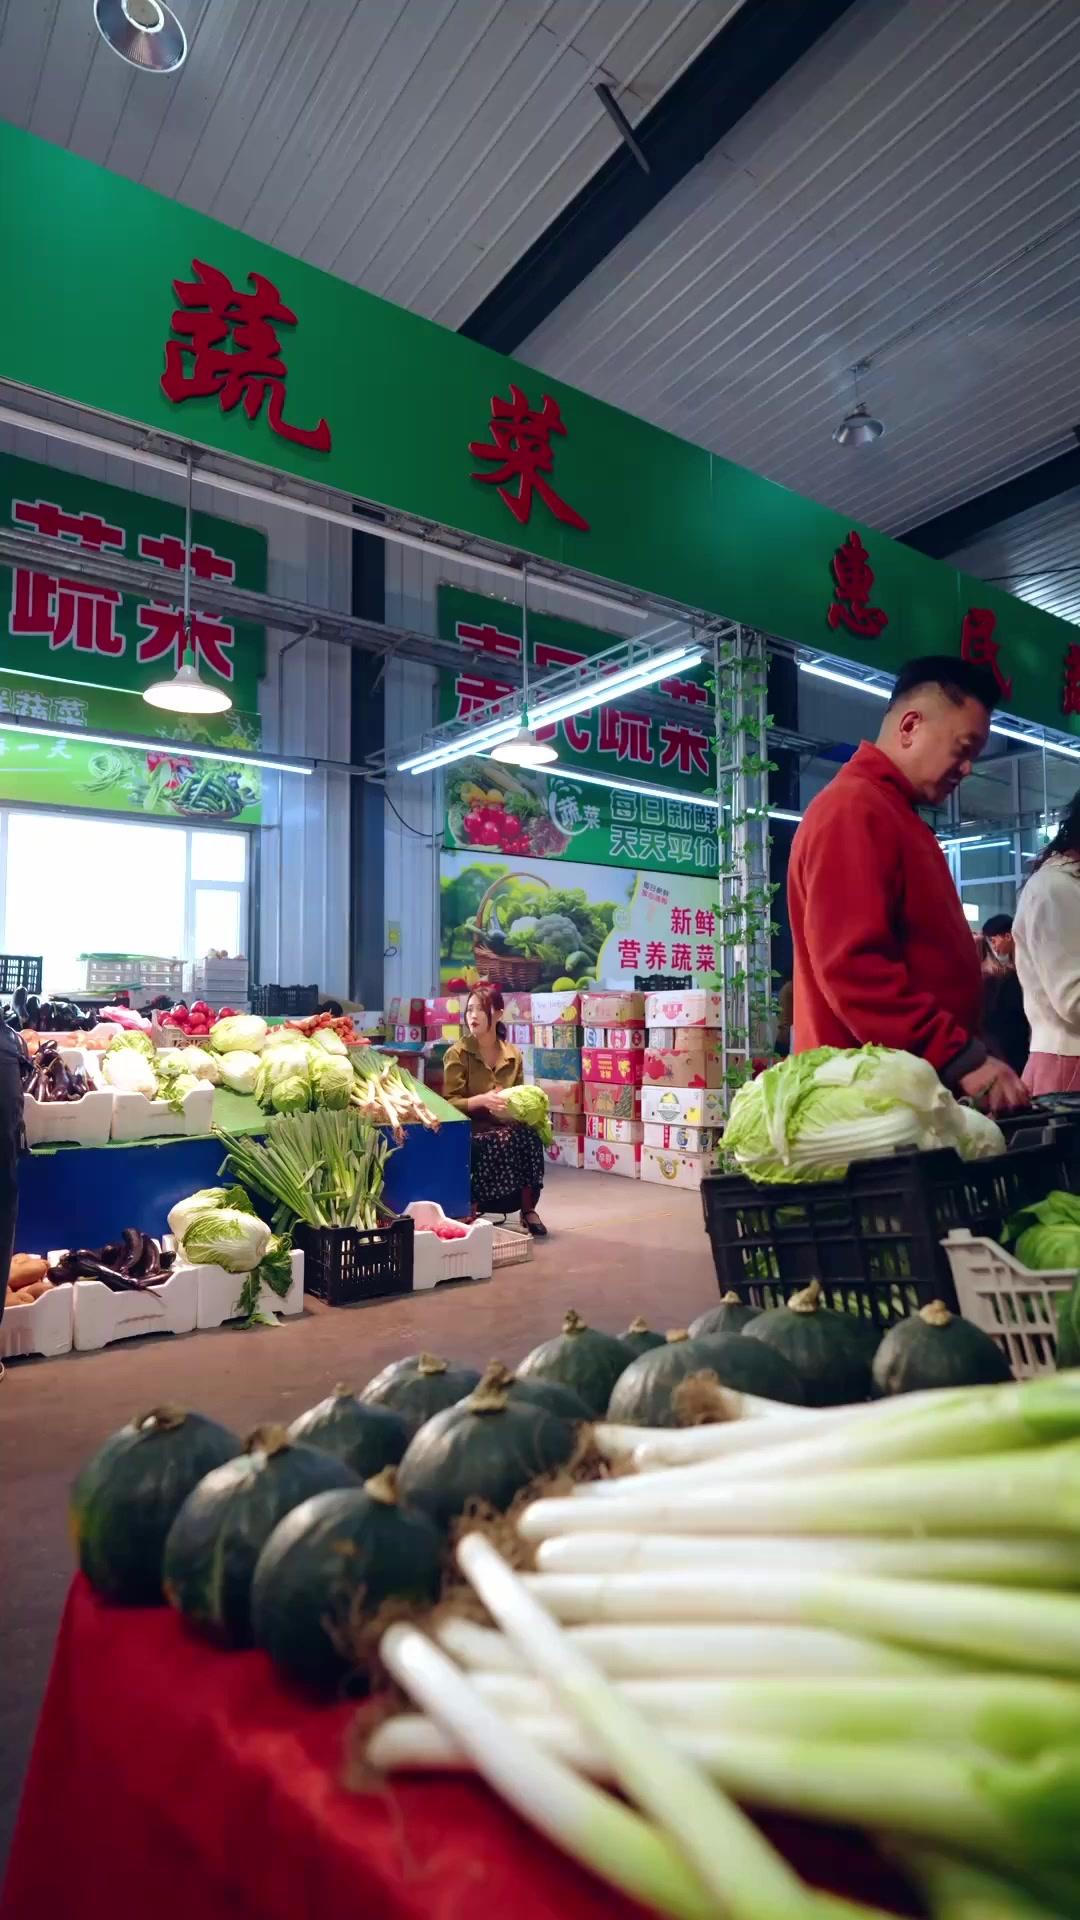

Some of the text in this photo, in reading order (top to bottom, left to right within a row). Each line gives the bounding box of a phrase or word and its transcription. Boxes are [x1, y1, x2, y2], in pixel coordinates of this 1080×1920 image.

[160, 258, 591, 533] 蔬菜
[9, 498, 236, 682] 蔬菜
[556, 796, 600, 830] 蔬菜
[610, 788, 718, 834] 每日新鲜
[609, 824, 718, 868] 天天平价
[671, 906, 716, 937] 新鲜
[618, 939, 716, 973] 营养蔬菜
